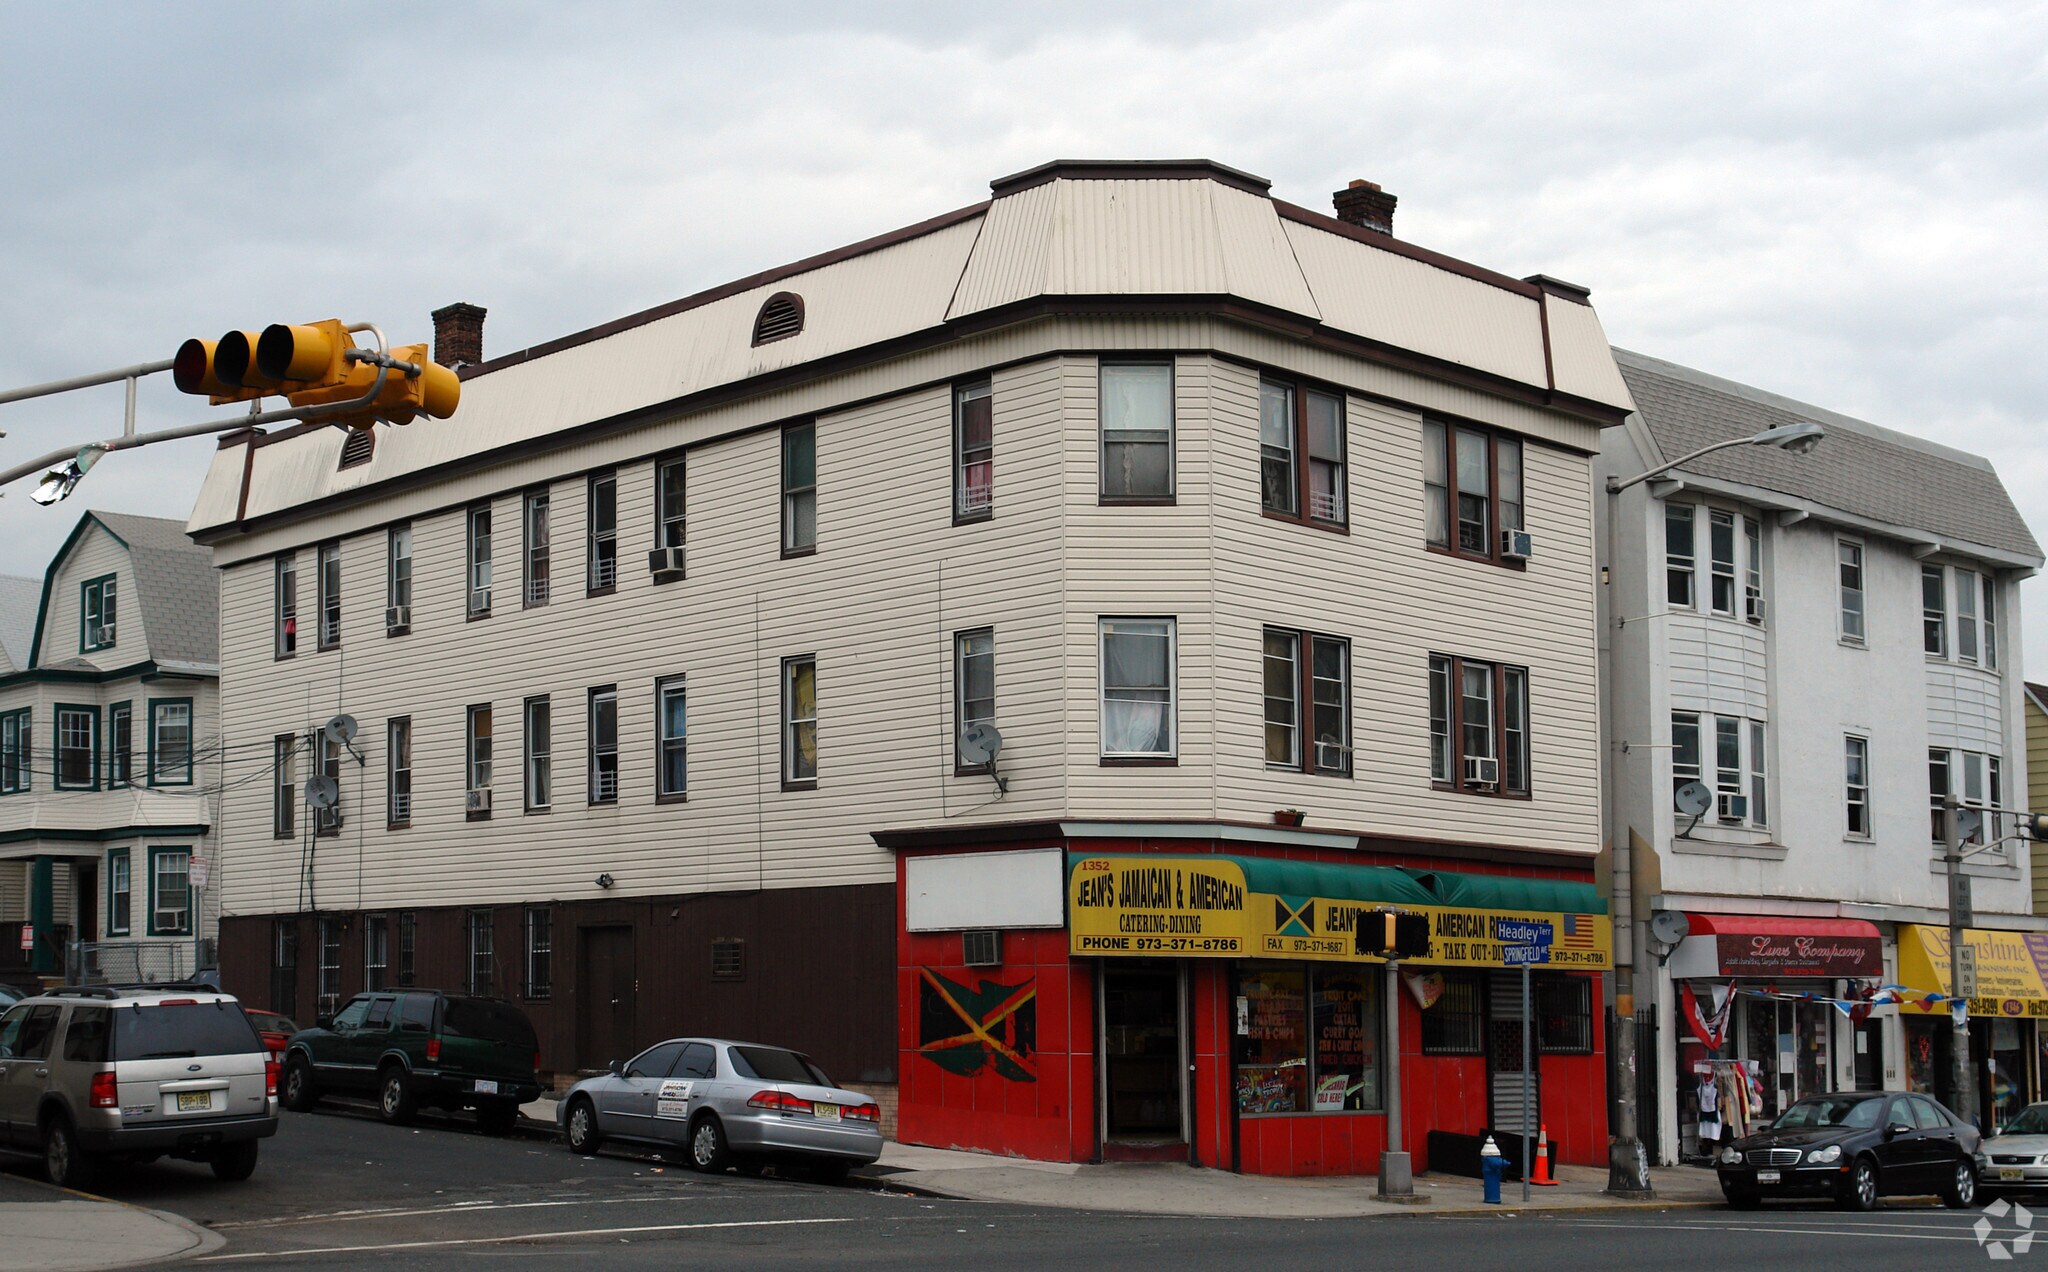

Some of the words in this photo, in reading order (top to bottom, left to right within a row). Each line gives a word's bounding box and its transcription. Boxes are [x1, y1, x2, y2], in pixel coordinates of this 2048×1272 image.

[1082, 861, 1110, 871] 1352
[1078, 872, 1114, 908] JEAN'S
[1119, 868, 1171, 909] JAMAICAN
[1176, 869, 1184, 909] &
[1190, 872, 1243, 911] AMERICAN
[1326, 907, 1361, 932] JEAN'
[1436, 913, 1485, 939] AMERICAN
[1498, 923, 1539, 943] Headley
[1539, 926, 1551, 936] Terr
[1083, 937, 1130, 949] PHONE
[1137, 938, 1238, 950] 973-371-8786
[1267, 938, 1283, 950] FAX
[1444, 942, 1468, 960] TAKE
[1504, 946, 1541, 963] SPRINGFIELD
[1794, 936, 1866, 964] Company
[1961, 950, 1970, 960] NO
[1555, 951, 1604, 963] 973-371-8786
[1960, 963, 1972, 972] TURN
[1964, 974, 1971, 983] ON
[1963, 985, 1973, 995] RED
